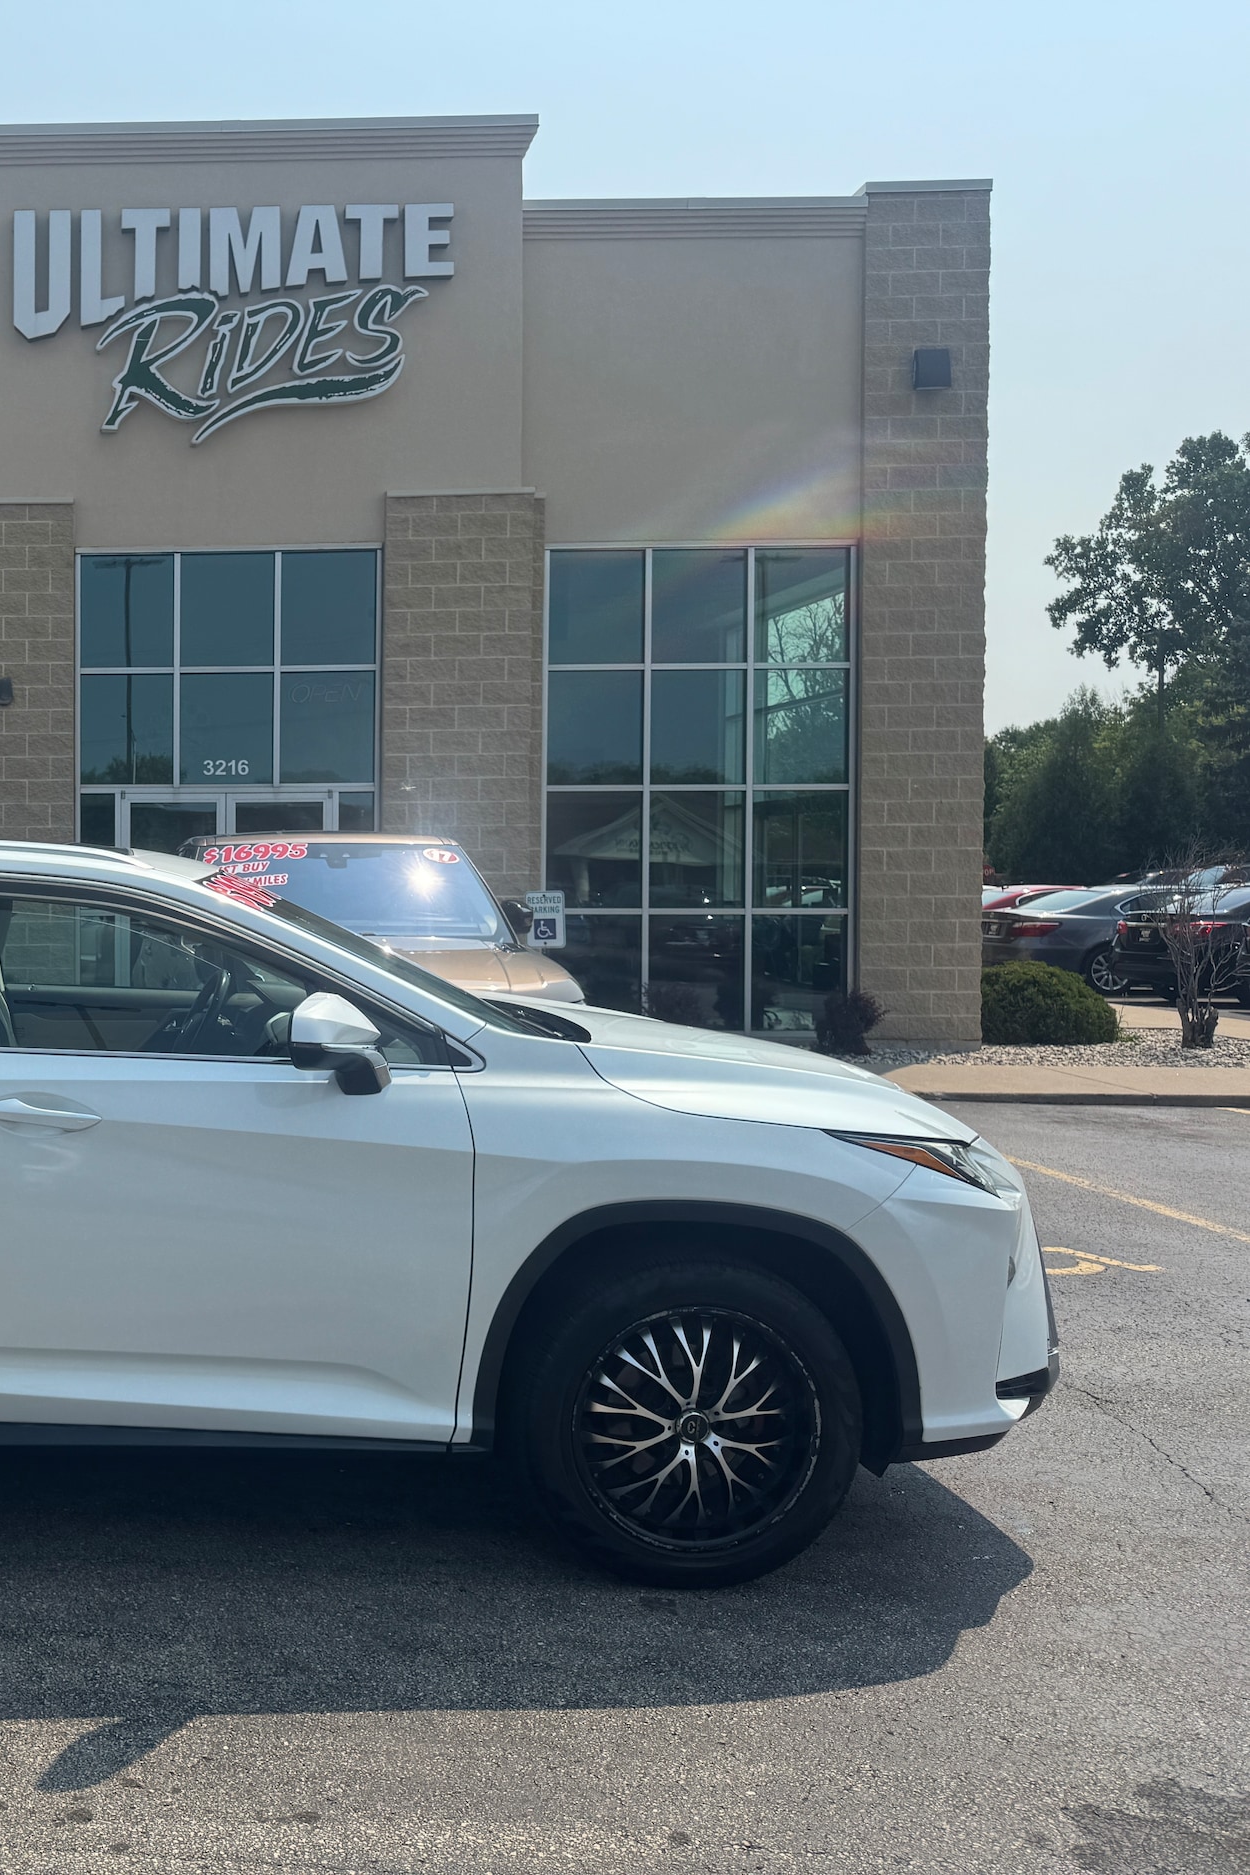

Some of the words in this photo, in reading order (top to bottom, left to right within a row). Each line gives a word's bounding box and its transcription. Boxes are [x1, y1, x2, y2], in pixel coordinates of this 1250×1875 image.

[13, 202, 455, 341] ULTIMATE
[291, 683, 362, 703] OPEN
[203, 759, 249, 776] 3216
[203, 843, 308, 864] $16995
[242, 861, 269, 873] BUY
[252, 874, 287, 886] MILES
[527, 896, 561, 904] RESERVED
